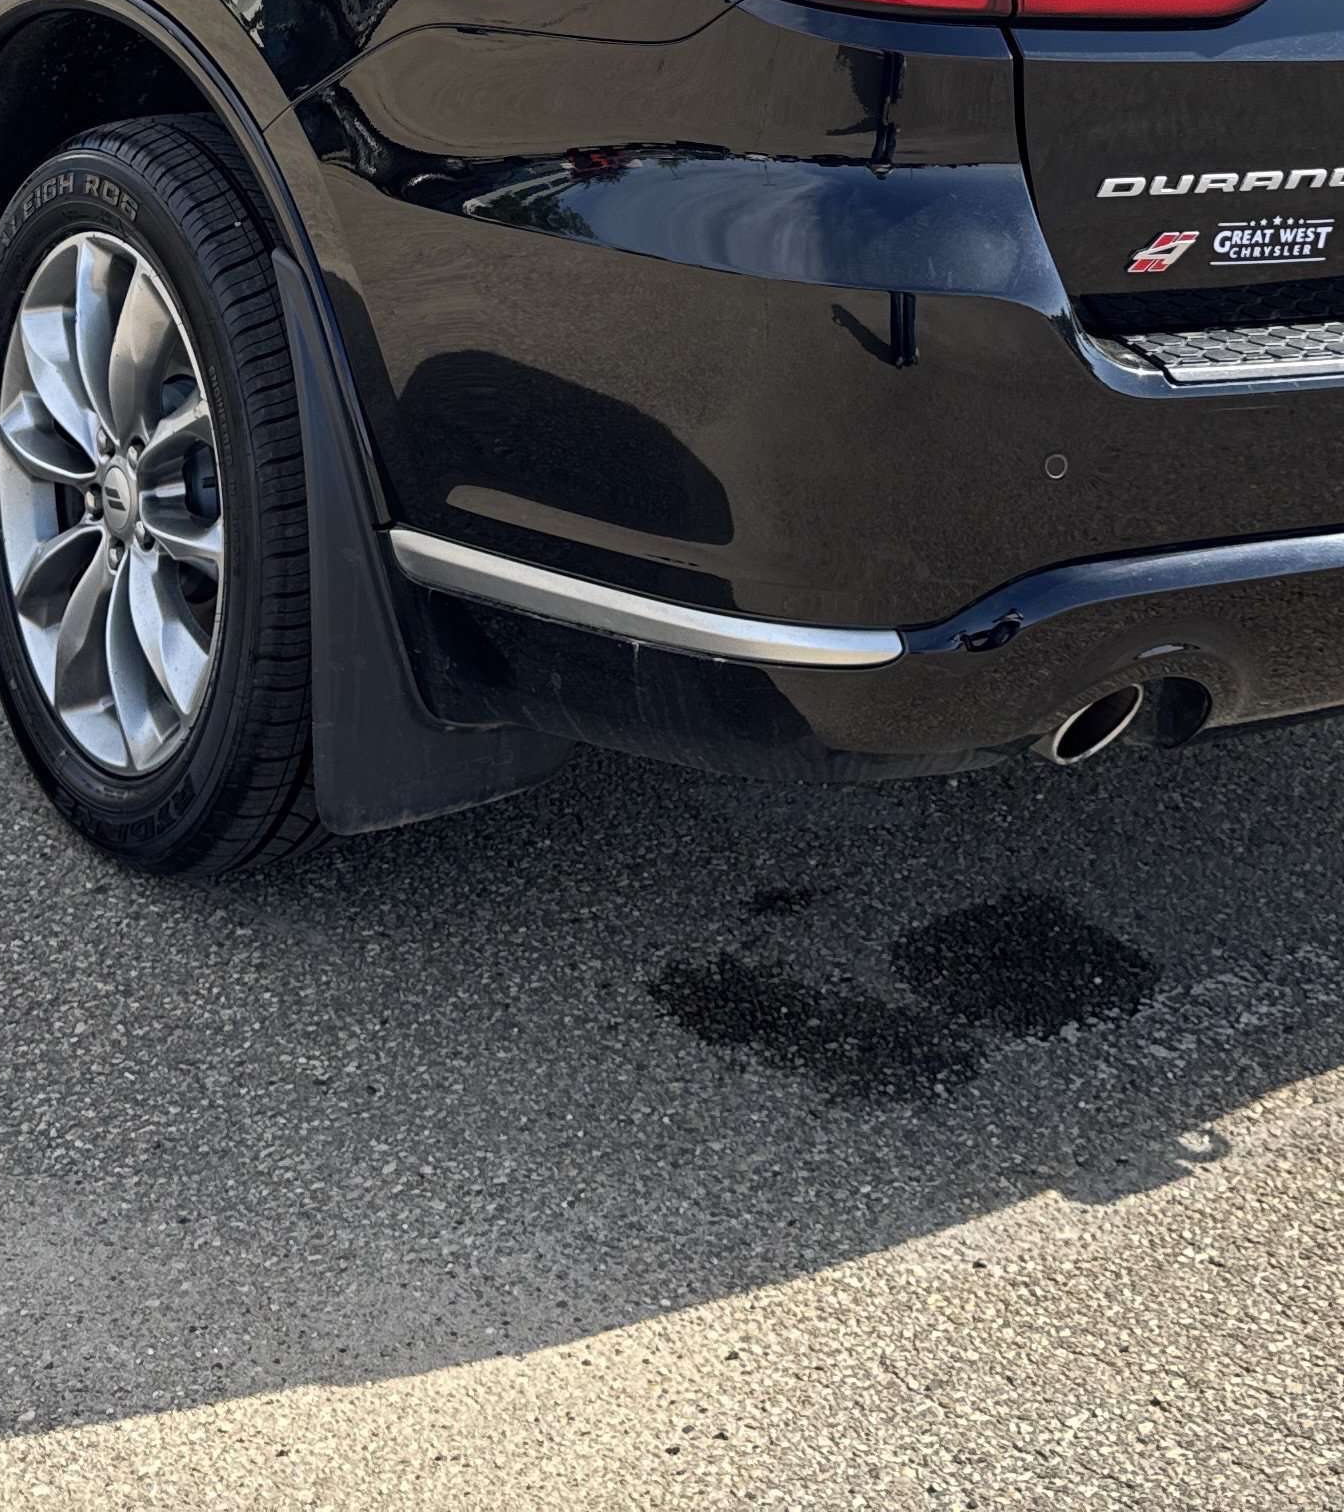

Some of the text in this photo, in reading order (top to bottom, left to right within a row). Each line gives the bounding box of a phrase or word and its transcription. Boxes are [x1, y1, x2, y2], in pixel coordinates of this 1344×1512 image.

[1213, 226, 1333, 254] GREAT WEST
[1229, 244, 1312, 259] CHRYSLER
